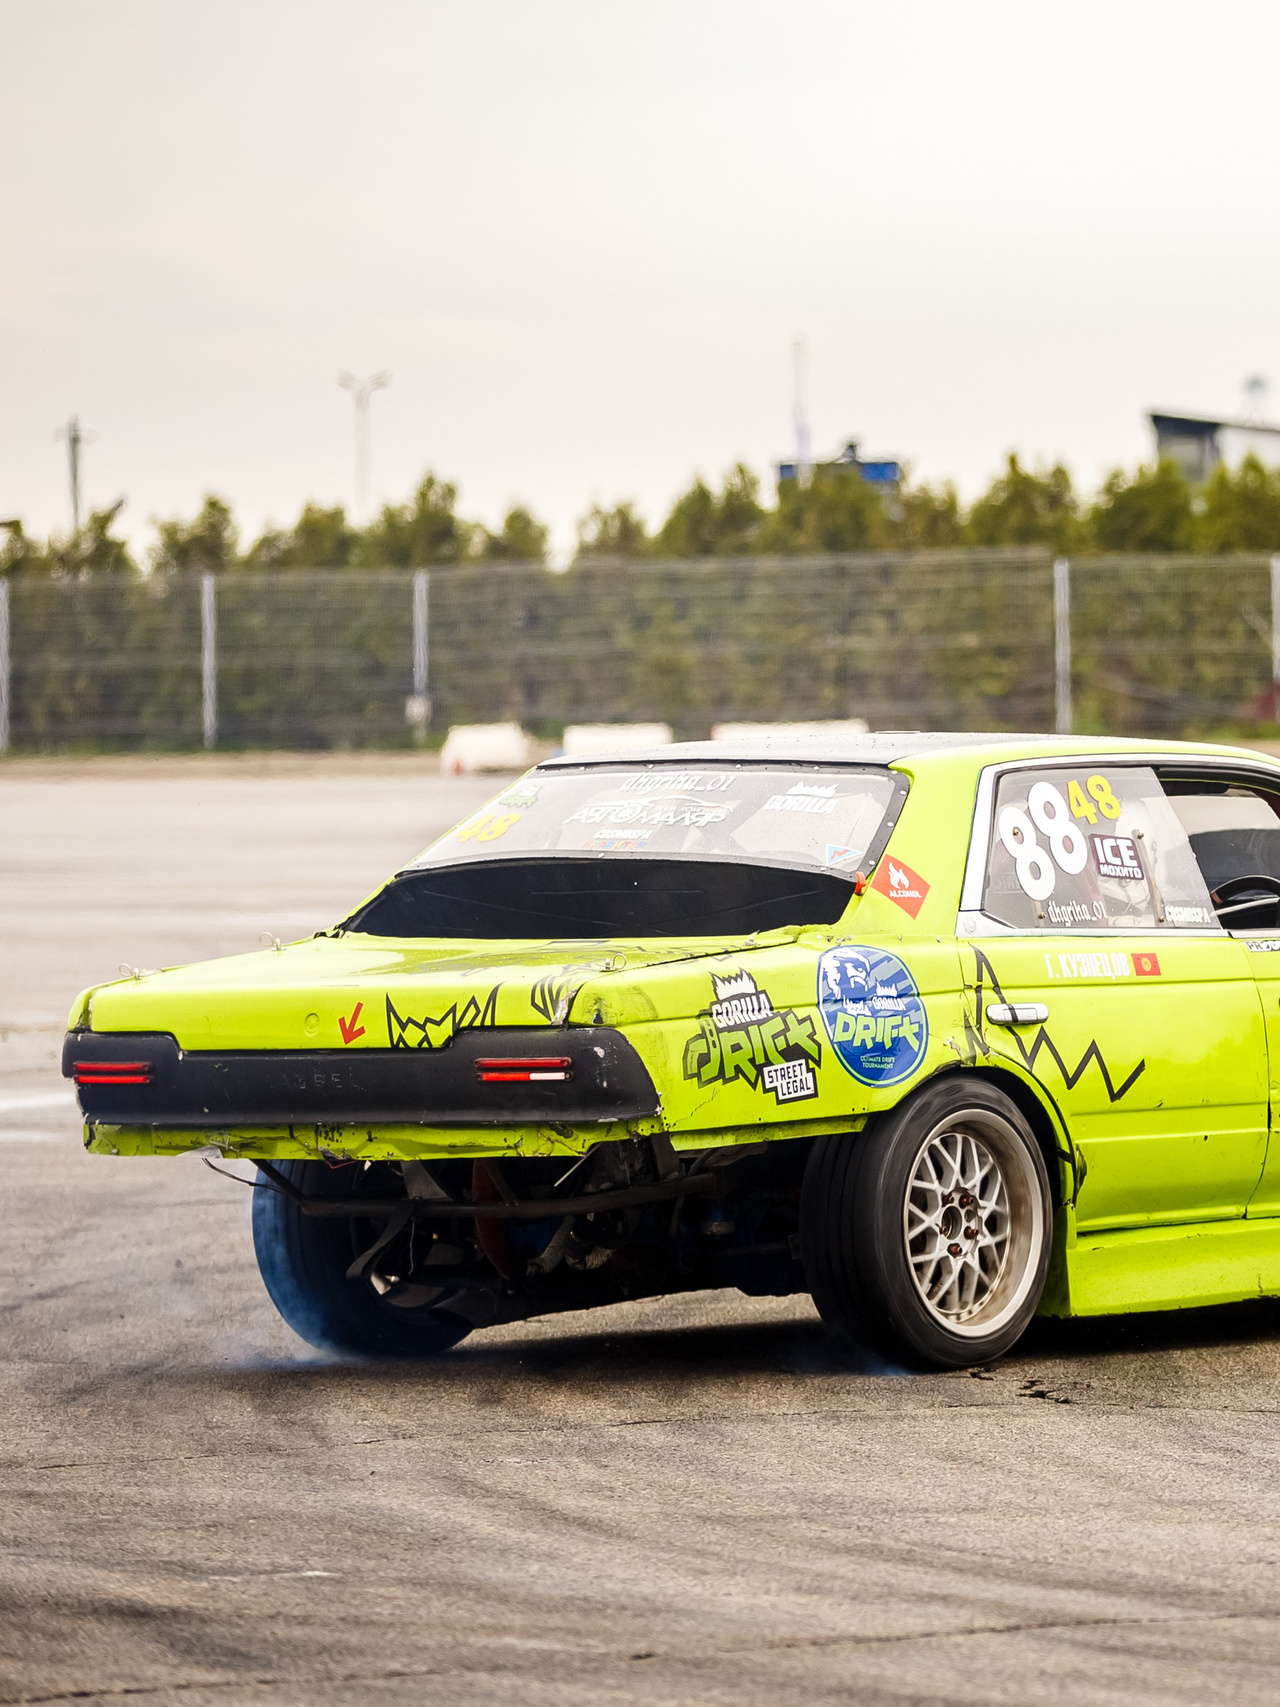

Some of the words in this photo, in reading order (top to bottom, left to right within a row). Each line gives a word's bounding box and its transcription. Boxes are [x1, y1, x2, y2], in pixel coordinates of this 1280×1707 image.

[762, 794, 838, 814] GORILLA
[1067, 775, 1122, 825] 48
[562, 802, 726, 828] АВТОМАЛЯР
[455, 813, 521, 842] 48
[999, 782, 1088, 901] 88
[1093, 837, 1139, 867] ICE
[1099, 864, 1143, 879] МОХИТО
[889, 890, 922, 898] ALCOHOL
[1164, 904, 1212, 924] COSMOSPA
[1058, 952, 1132, 980] КУЗНЕЦОВ
[710, 995, 774, 1029] GORILLA
[872, 995, 907, 1011] GORILLA
[833, 1011, 922, 1053] DRIFT
[860, 1055, 881, 1063] ULTIMATE
[767, 1062, 804, 1085] STREET
[779, 1078, 812, 1098] LEGAL
